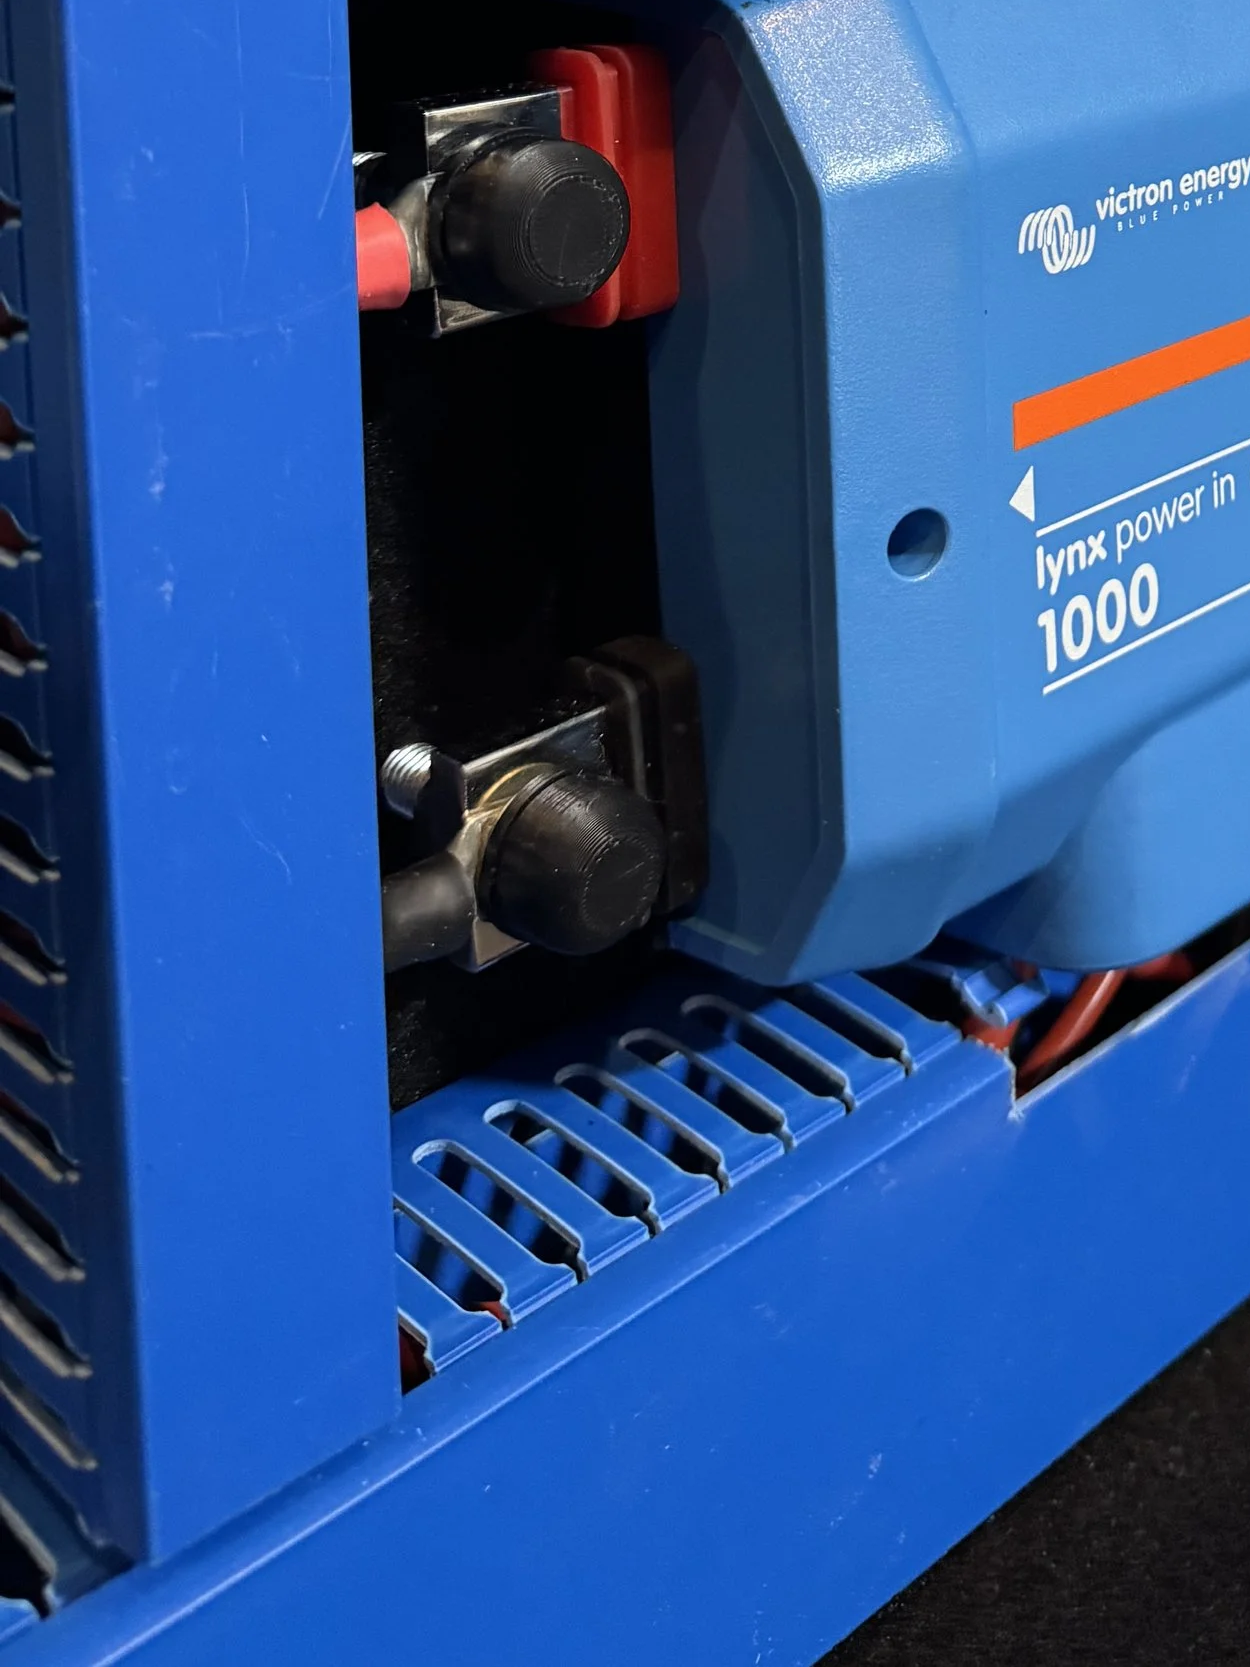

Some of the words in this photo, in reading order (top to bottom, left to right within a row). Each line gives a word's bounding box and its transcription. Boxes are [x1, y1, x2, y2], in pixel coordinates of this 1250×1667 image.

[1096, 178, 1174, 222] victron
[1117, 210, 1159, 233] BLUE
[1172, 190, 1225, 215] POWER
[1036, 530, 1108, 597] lynx
[1116, 485, 1205, 565] power
[1212, 470, 1236, 509] in
[1037, 562, 1160, 674] 1000
